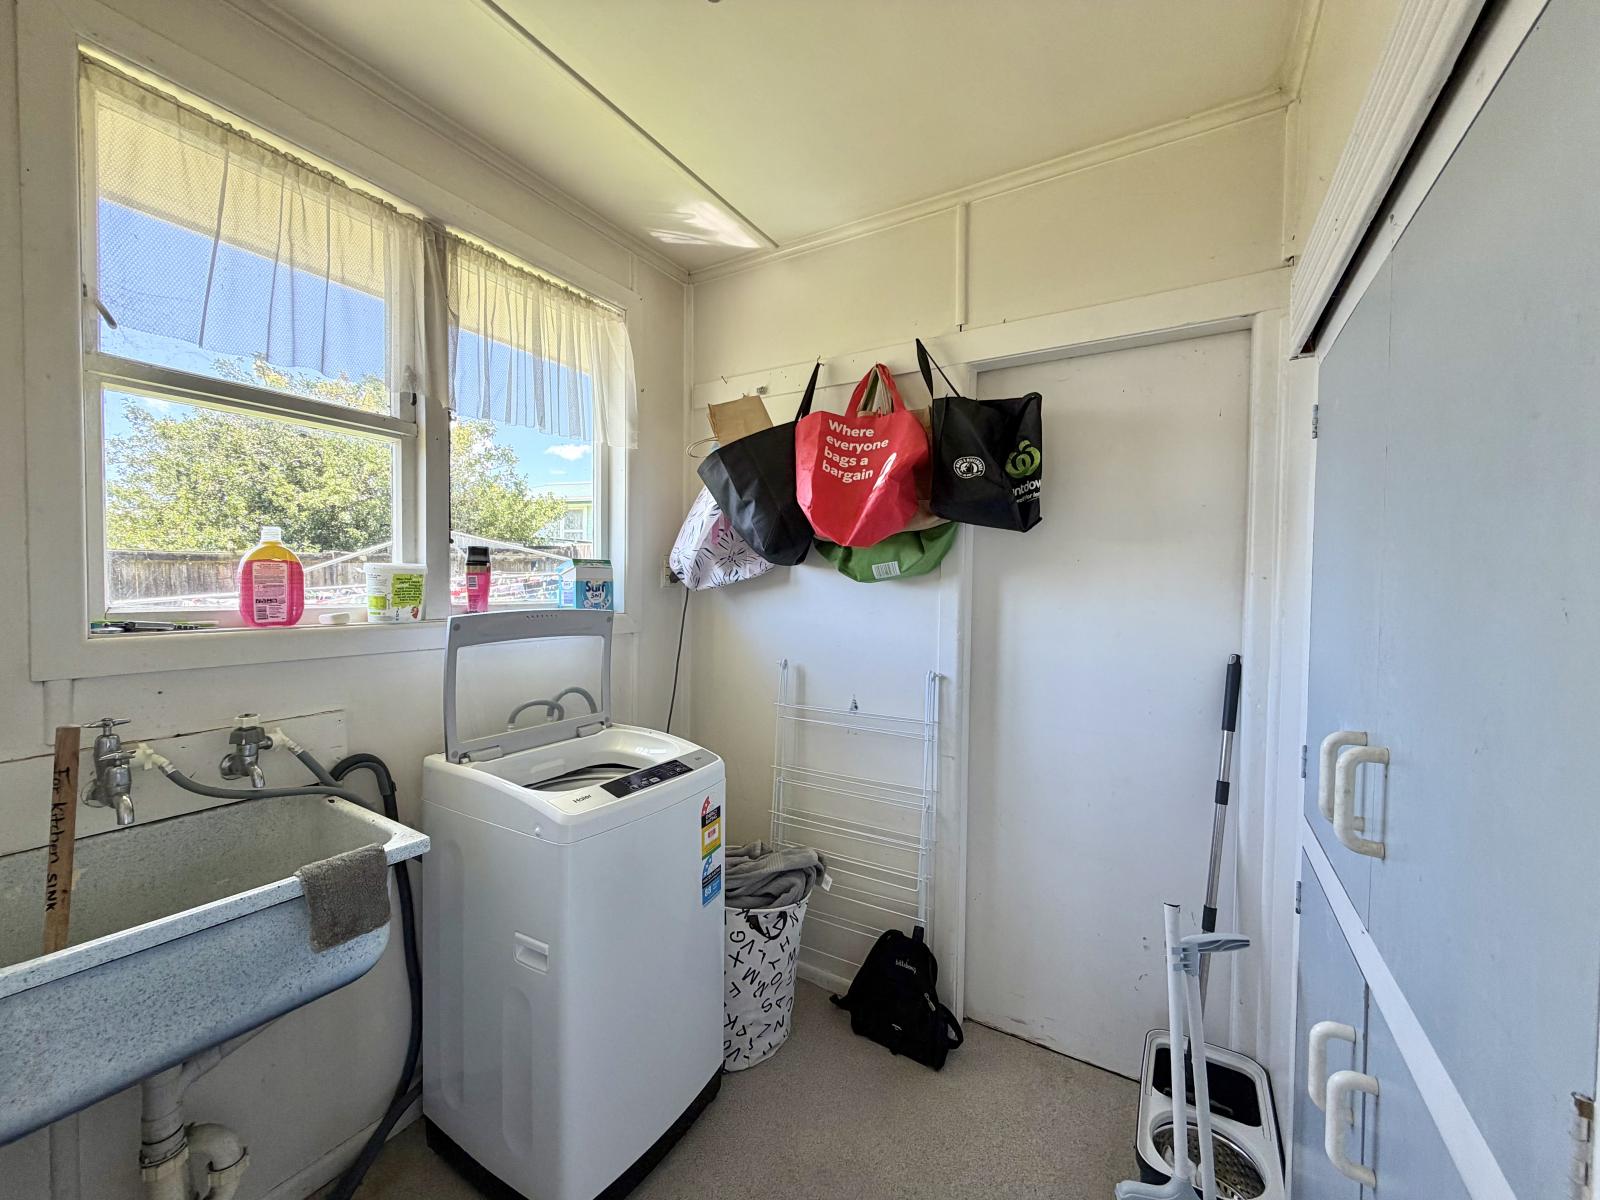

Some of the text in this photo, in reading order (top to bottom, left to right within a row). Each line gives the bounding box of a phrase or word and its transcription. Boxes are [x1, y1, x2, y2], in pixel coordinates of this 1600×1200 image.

[828, 419, 874, 437] Where
[826, 435, 889, 454] everyone
[824, 446, 869, 468] bags a
[822, 460, 874, 484] bargain
[585, 580, 607, 592] Surf
[572, 794, 592, 804] Haier
[45, 873, 58, 912] SINK
